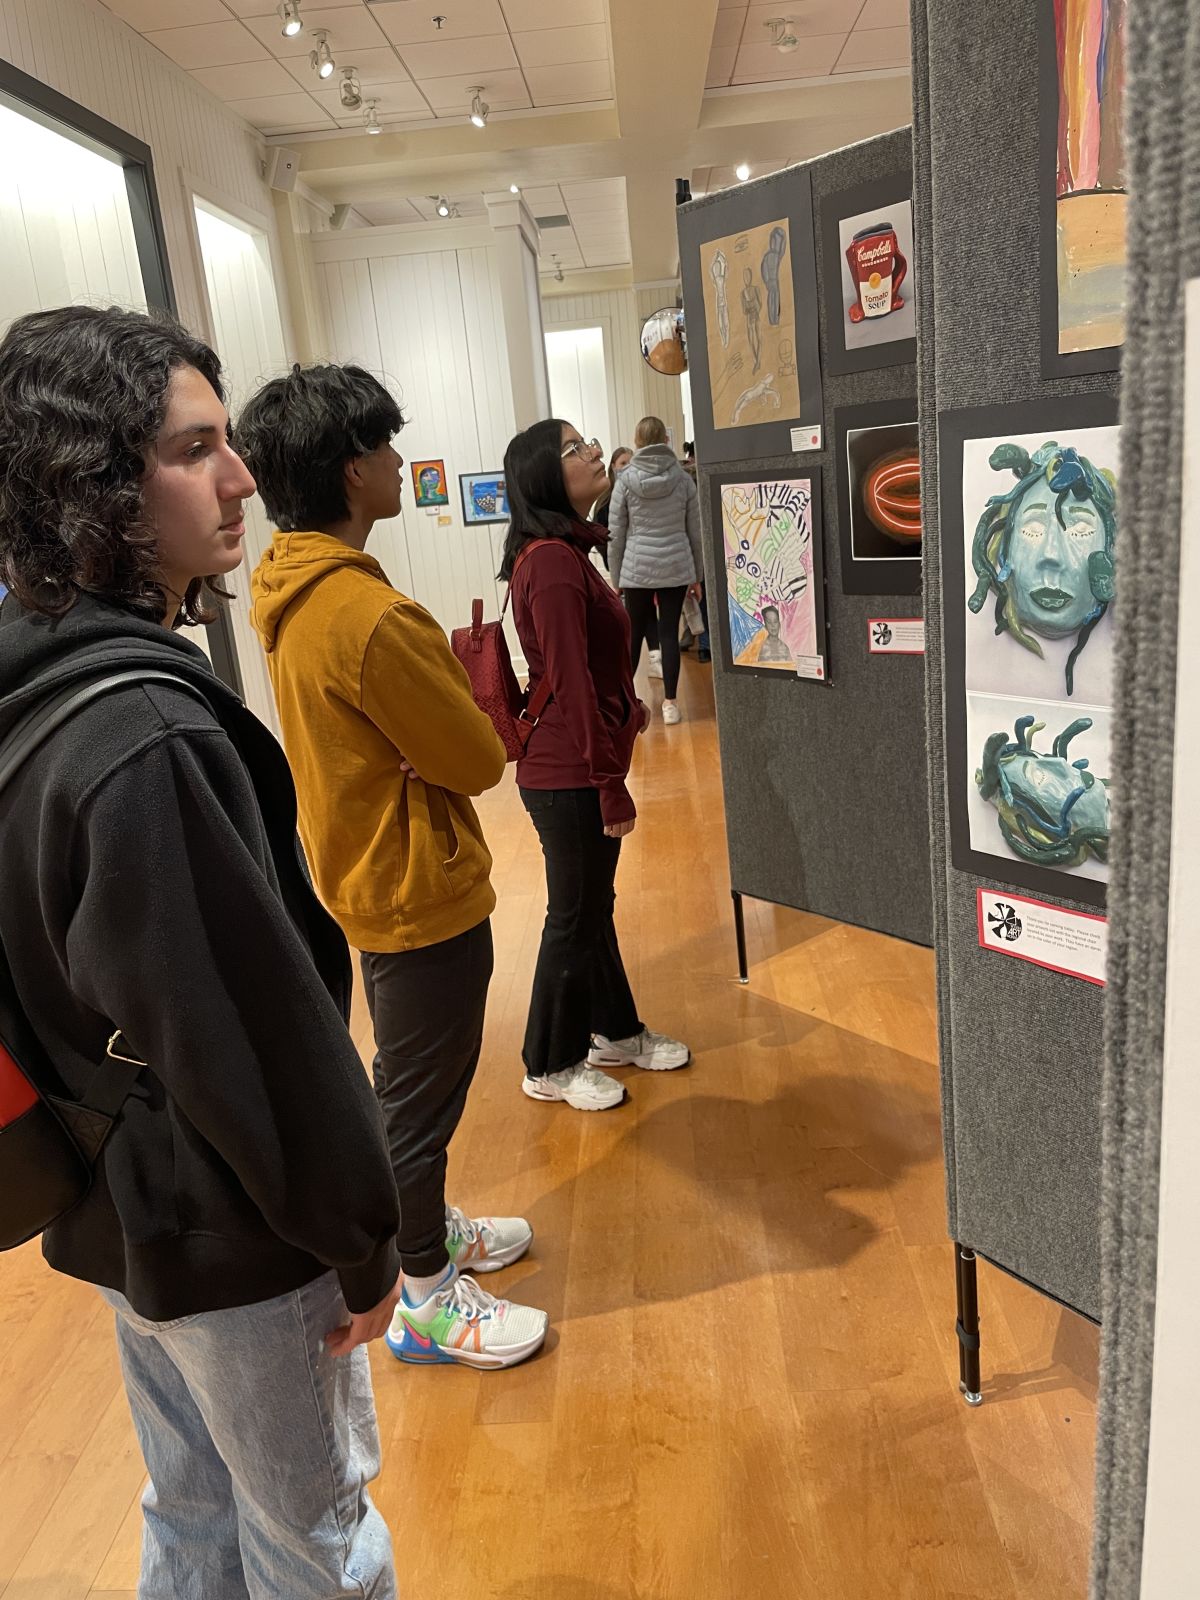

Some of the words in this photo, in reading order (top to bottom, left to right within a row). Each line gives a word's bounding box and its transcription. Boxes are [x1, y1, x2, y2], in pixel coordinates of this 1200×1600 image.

[864, 291, 889, 303] Tomato
[868, 300, 887, 310] SOUP
[1008, 927, 1021, 937] ART
